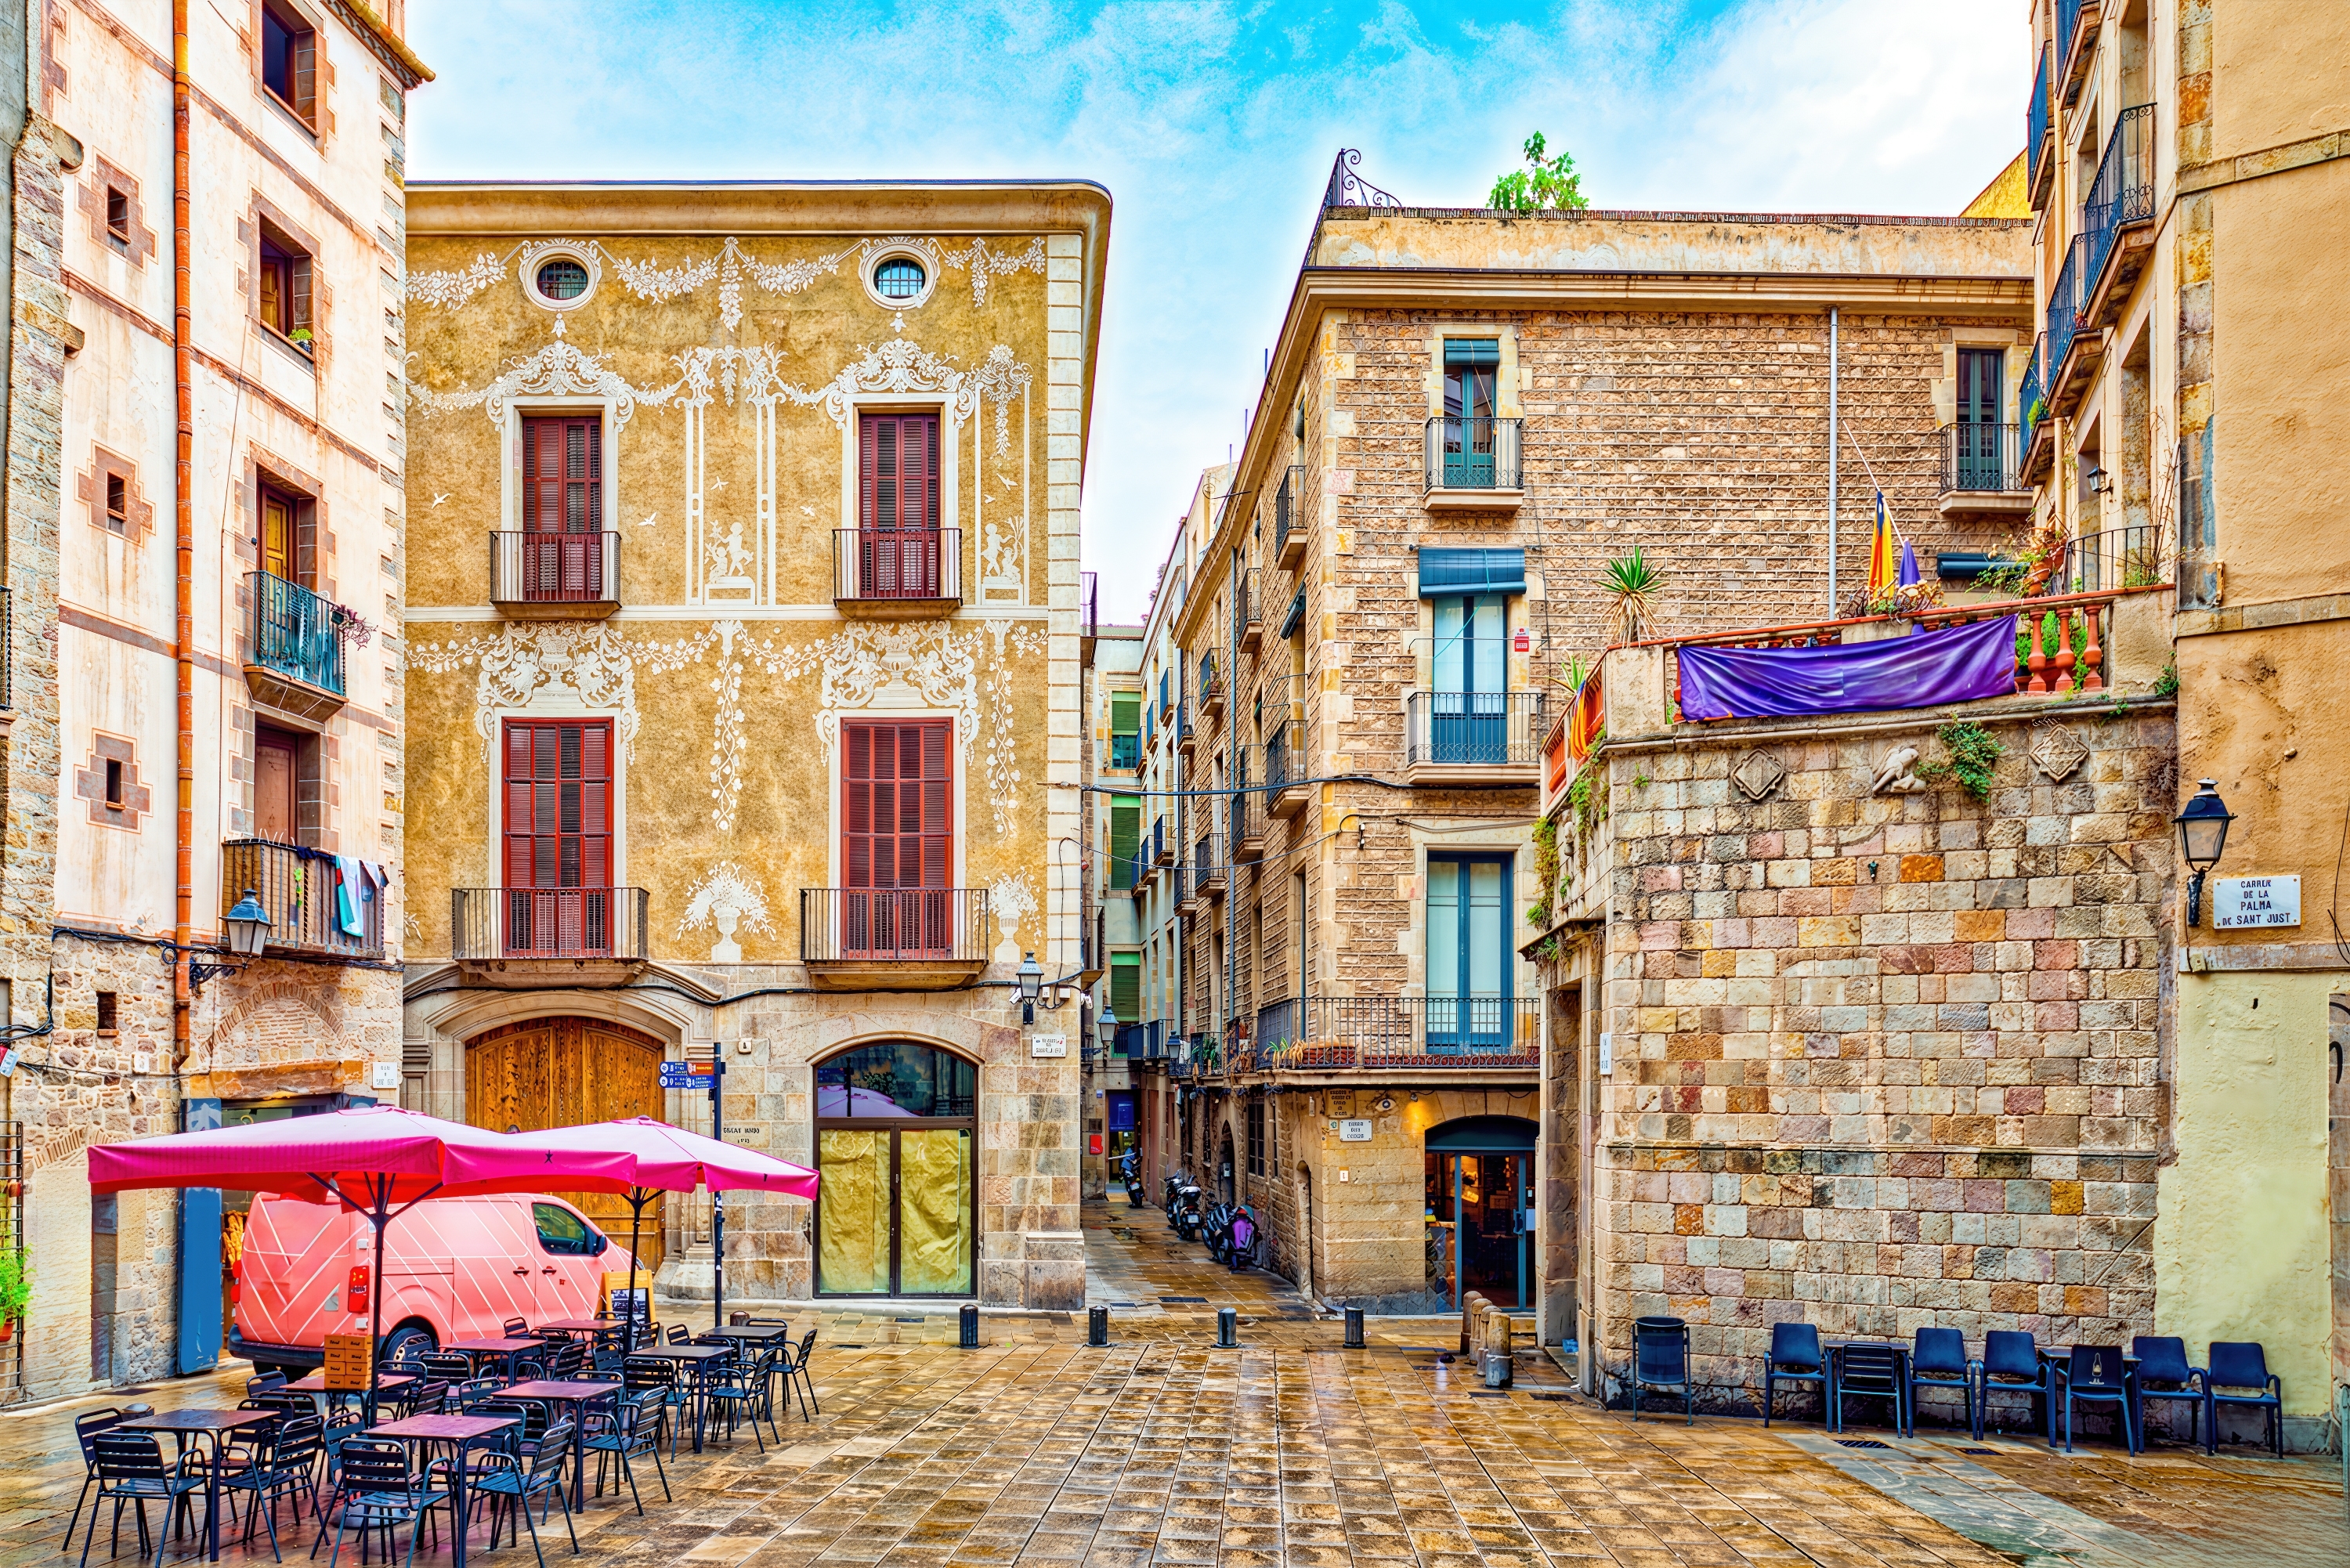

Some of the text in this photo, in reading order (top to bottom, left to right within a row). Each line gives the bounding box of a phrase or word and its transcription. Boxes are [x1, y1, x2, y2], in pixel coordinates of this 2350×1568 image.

[2243, 890, 2269, 899] DE LA
[2240, 900, 2272, 911] PALMA
[2236, 914, 2261, 925] SANT
[2267, 912, 2290, 923] JUST
